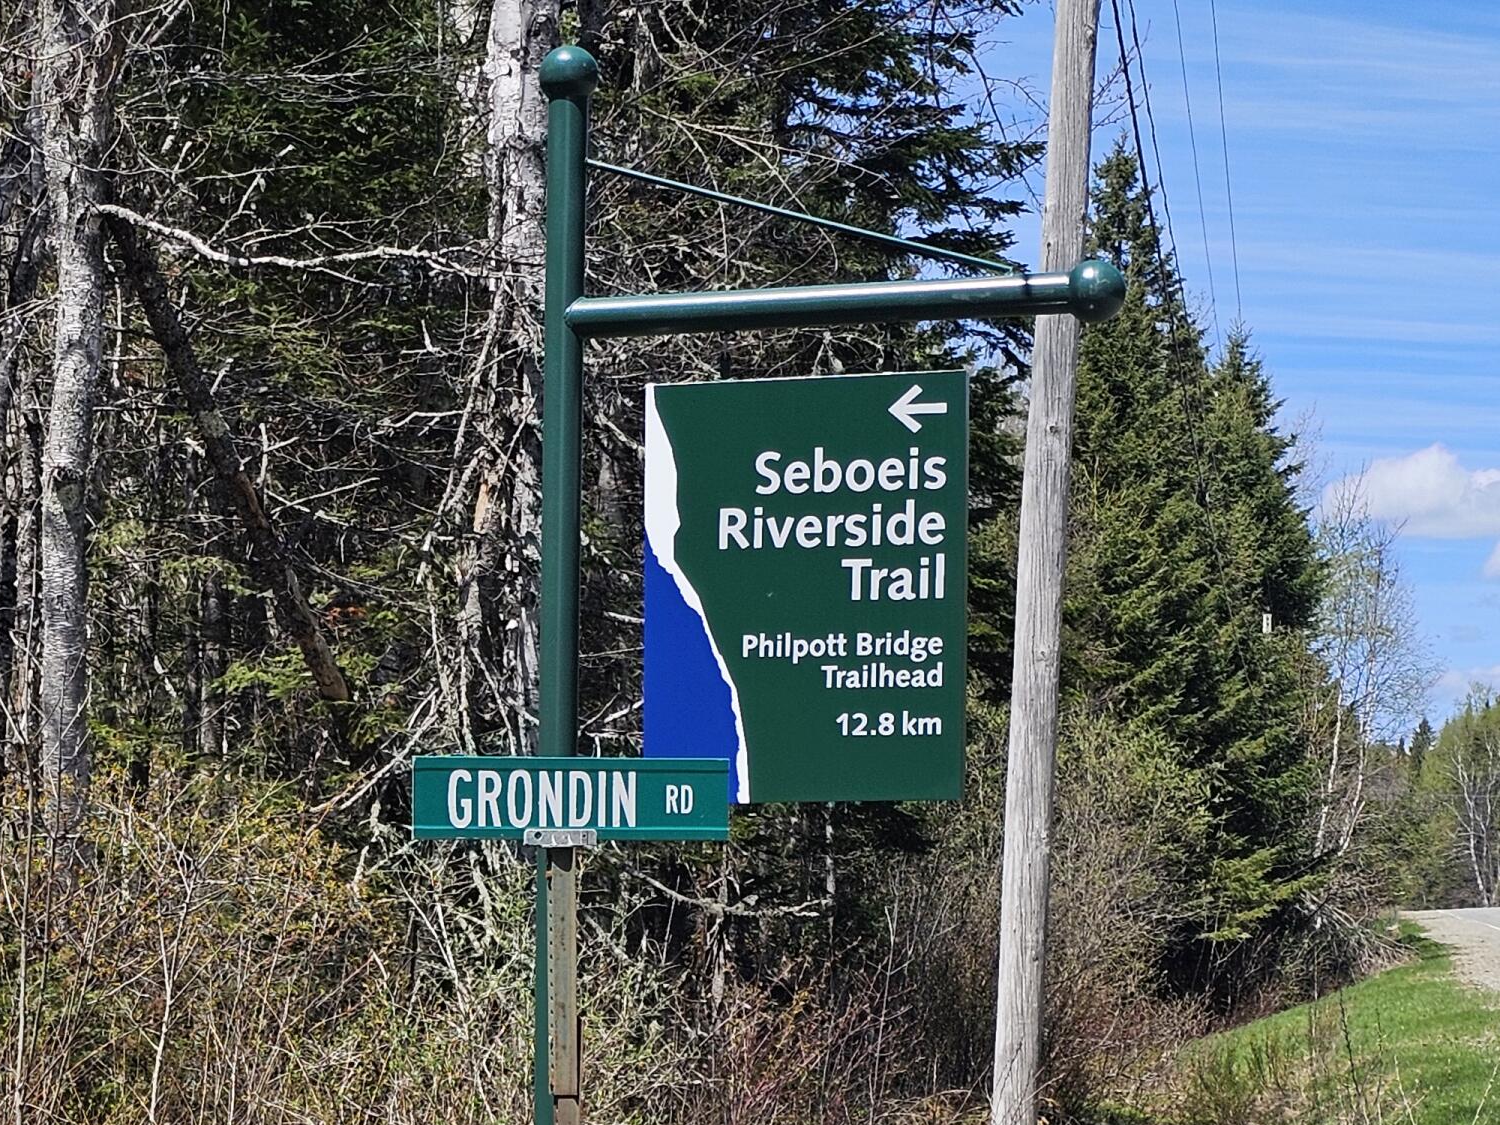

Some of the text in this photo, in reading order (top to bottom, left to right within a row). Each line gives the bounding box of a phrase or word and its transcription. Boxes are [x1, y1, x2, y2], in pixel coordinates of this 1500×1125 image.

[755, 446, 947, 495] Seboeis
[718, 498, 946, 550] Riverside
[841, 552, 946, 601] Trail
[742, 629, 944, 665] Philpott Bridge
[820, 661, 943, 689] Trailhead
[835, 710, 942, 736] 12.8 km
[447, 768, 694, 829] GRONDIN RD
